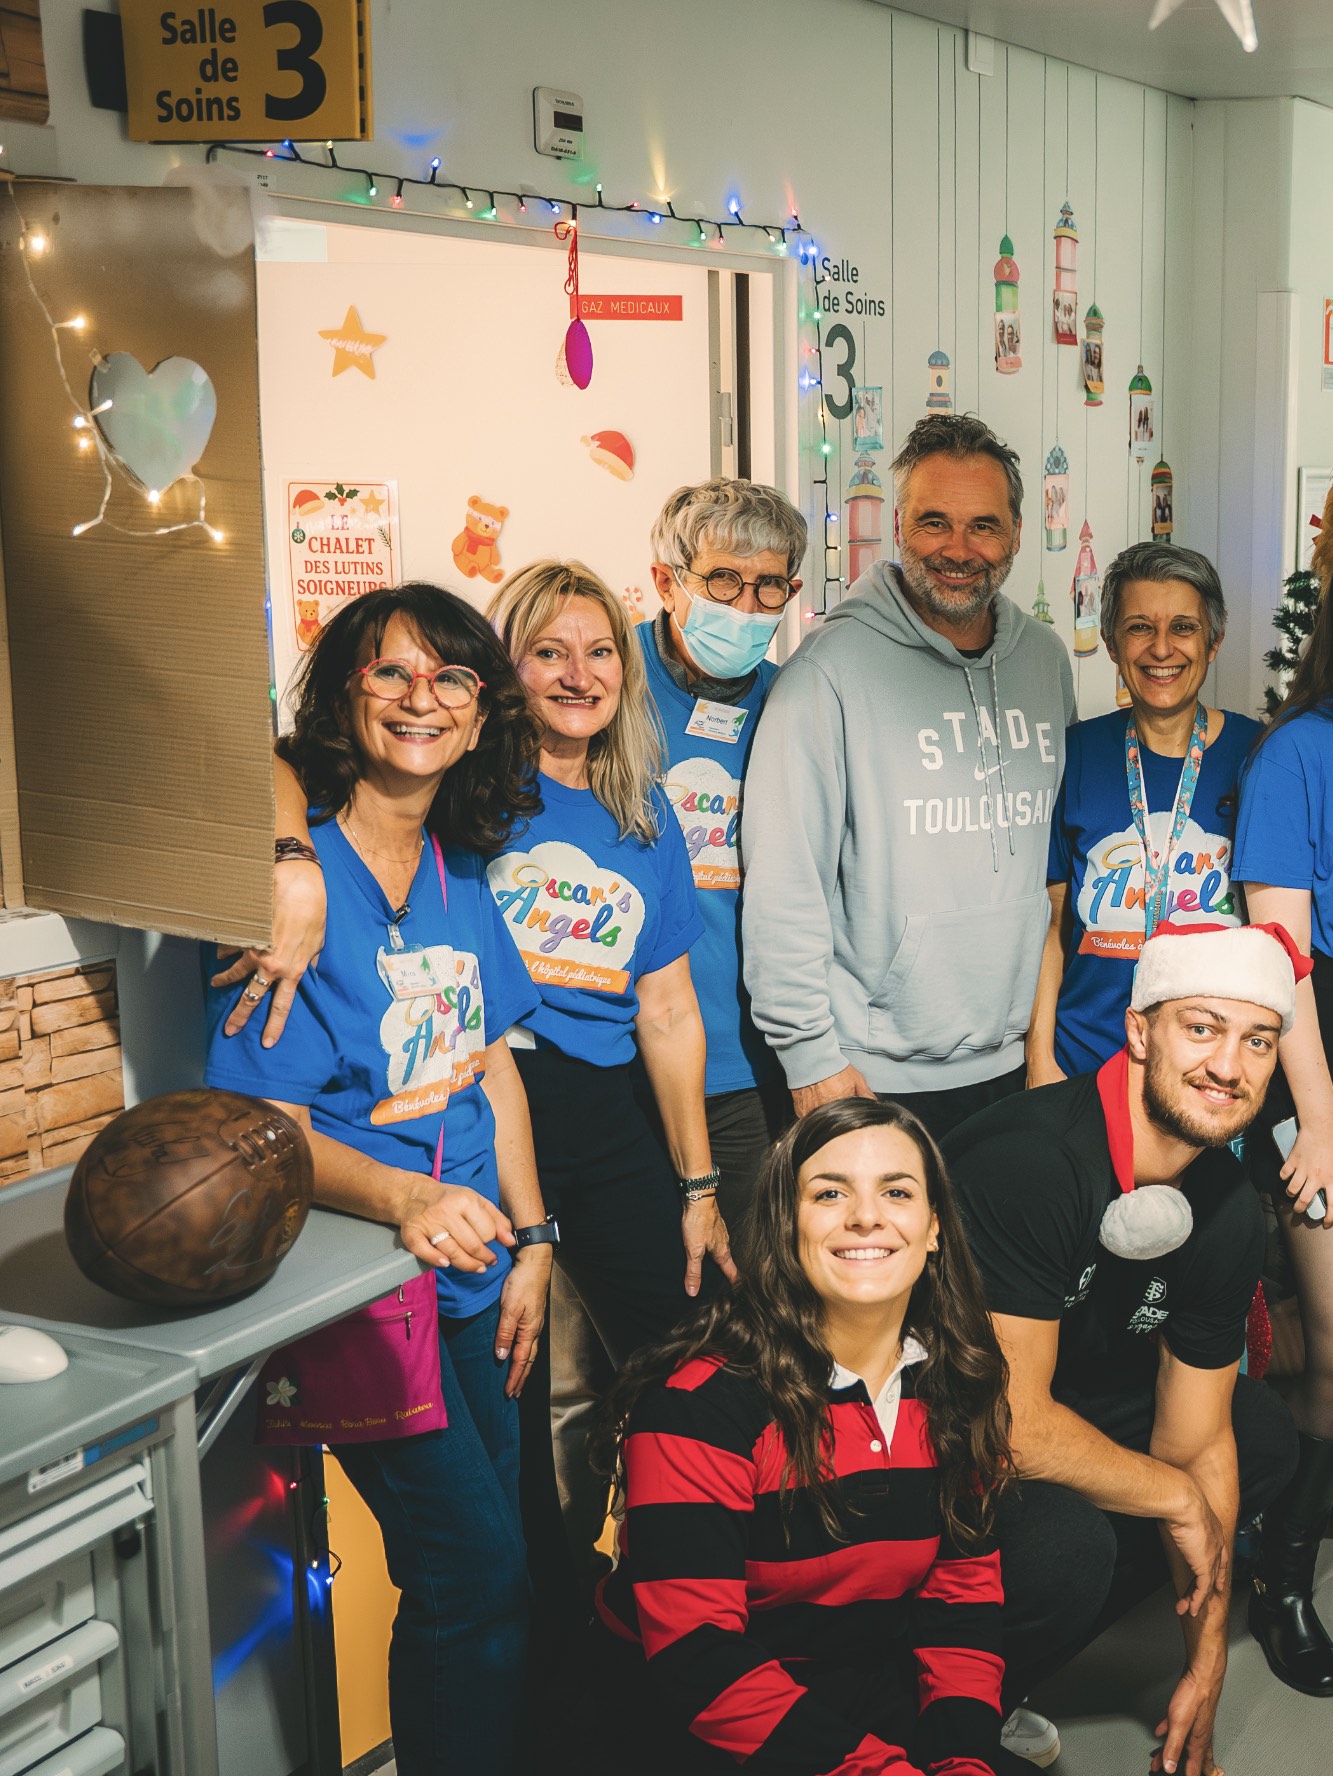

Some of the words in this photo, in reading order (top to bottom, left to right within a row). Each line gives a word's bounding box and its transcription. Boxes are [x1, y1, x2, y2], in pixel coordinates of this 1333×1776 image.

[160, 8, 237, 45] Salle
[199, 48, 239, 82] de
[262, 0, 327, 121] 3
[156, 87, 241, 123] Soins
[821, 257, 859, 284] Salle
[581, 301, 603, 314] GAZ
[610, 301, 670, 314] MEDICAUX
[822, 290, 840, 314] de
[845, 291, 886, 317] Soins
[824, 323, 856, 420] 3
[331, 514, 350, 531] LE
[308, 536, 375, 555] CHALET
[304, 560, 330, 575] DES
[334, 560, 384, 576] LUTINS
[705, 714, 728, 726] Norbert
[917, 705, 1056, 771] STADE
[512, 863, 632, 914] Oscar's
[496, 880, 622, 954] Angels
[1091, 936, 1136, 951] Bénévoles
[565, 968, 612, 987] pédiatrique
[392, 1091, 446, 1114] Bénévoles
